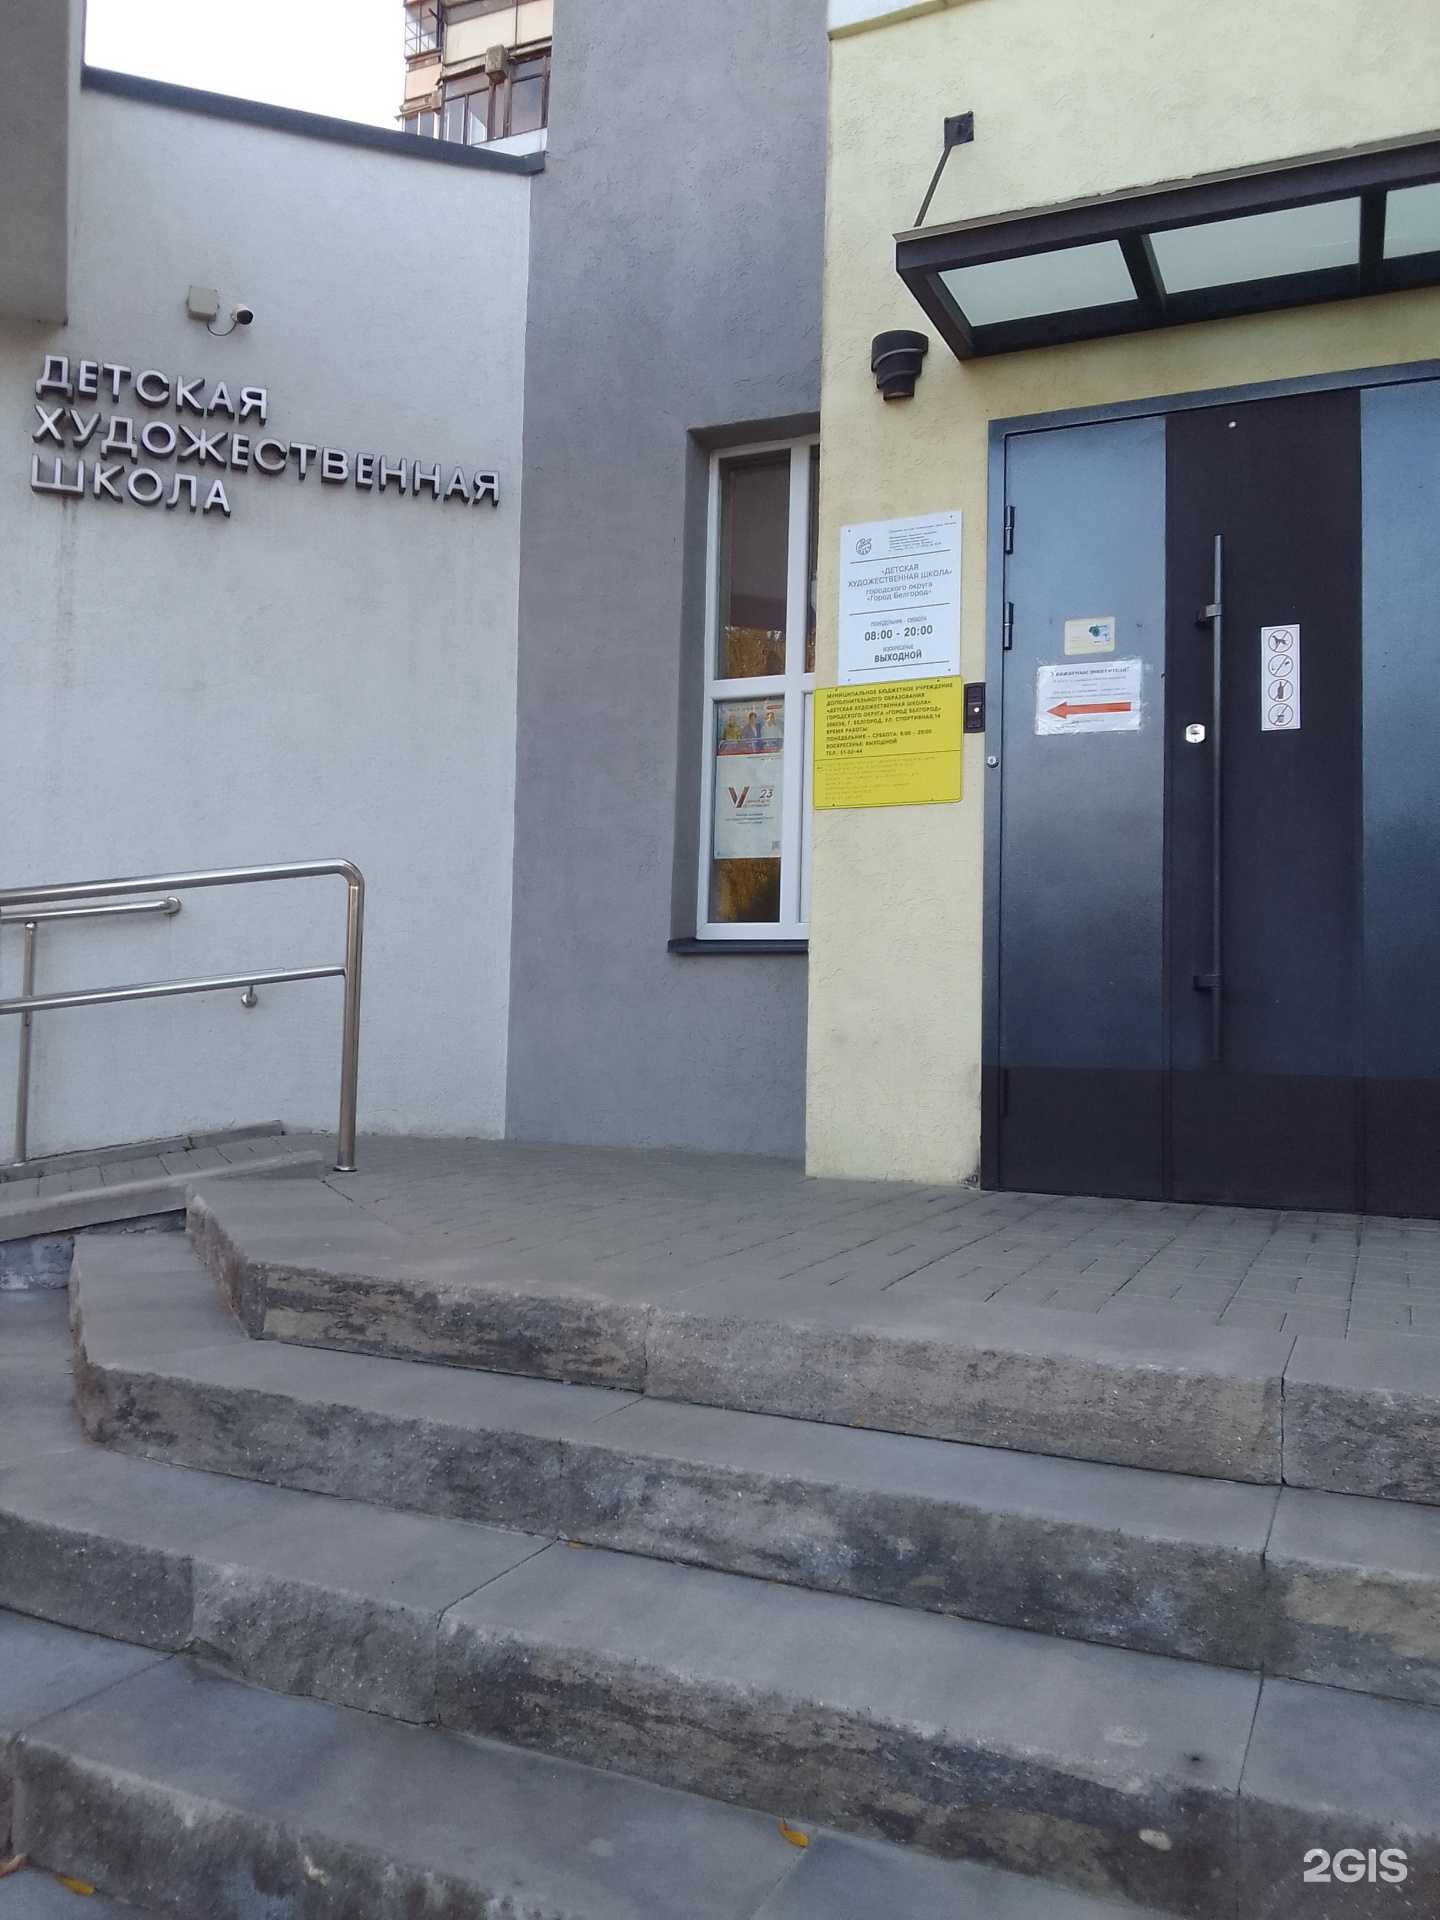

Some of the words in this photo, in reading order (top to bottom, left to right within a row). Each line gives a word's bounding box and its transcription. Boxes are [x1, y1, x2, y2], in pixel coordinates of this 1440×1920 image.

[35, 354, 269, 425] ДЕТСКАЯ
[32, 404, 500, 508] ХУДОЖЕСТВЕННАЯ
[31, 453, 231, 517] ШКОЛА
[848, 572, 919, 588] ХУДОЖЕСТВЕННАЯ
[866, 584, 907, 595] городского
[909, 581, 933, 591] округа
[864, 629, 893, 642] 08:00
[904, 624, 933, 637] 20:00
[874, 649, 922, 663] ВЫХОДНОЙ
[826, 689, 877, 698] МУНИЦИПАЛЬНОЕ
[879, 686, 913, 695] БЮДЖЕТНОЕ
[915, 682, 953, 691] УЧРЕЖДЕНИЕ
